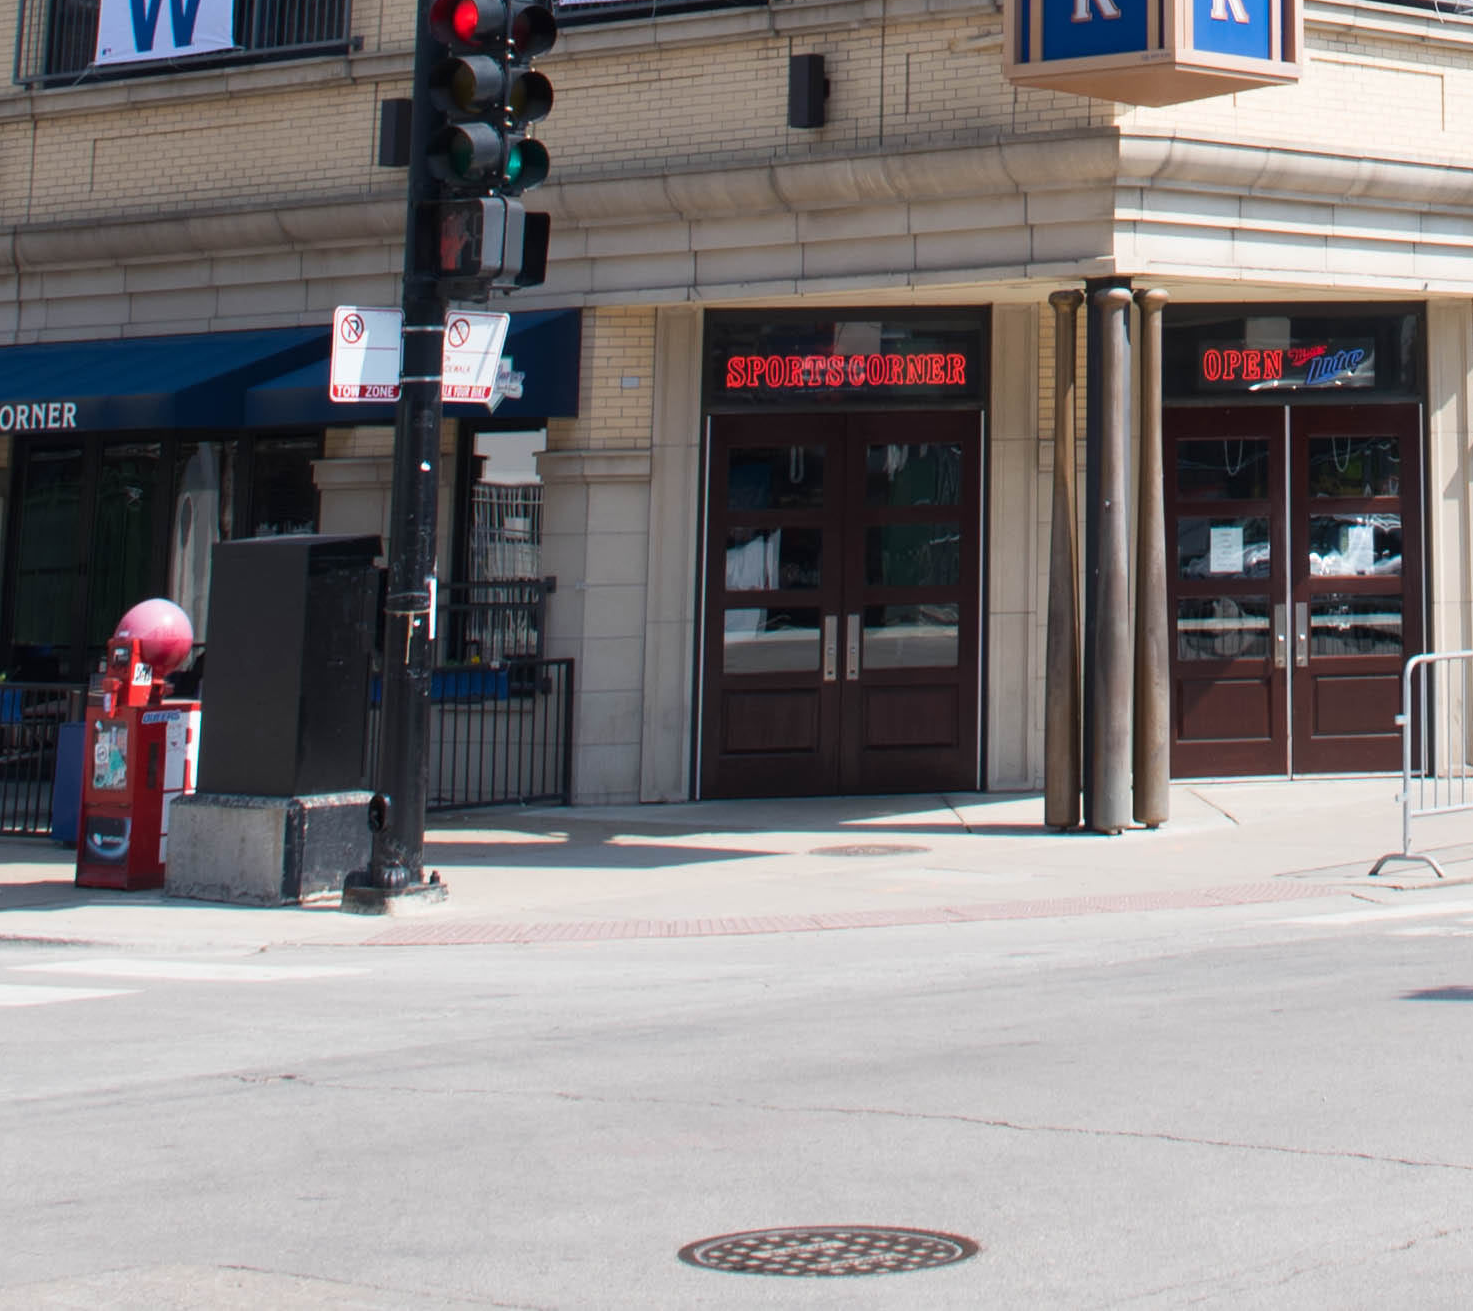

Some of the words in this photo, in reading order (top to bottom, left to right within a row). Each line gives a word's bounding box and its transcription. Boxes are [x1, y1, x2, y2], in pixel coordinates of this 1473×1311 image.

[726, 355, 844, 389] SPORTS
[847, 353, 967, 386] CORNER
[1203, 348, 1283, 381] OPEN
[336, 384, 360, 399] TOW
[365, 385, 395, 399] ZONE
